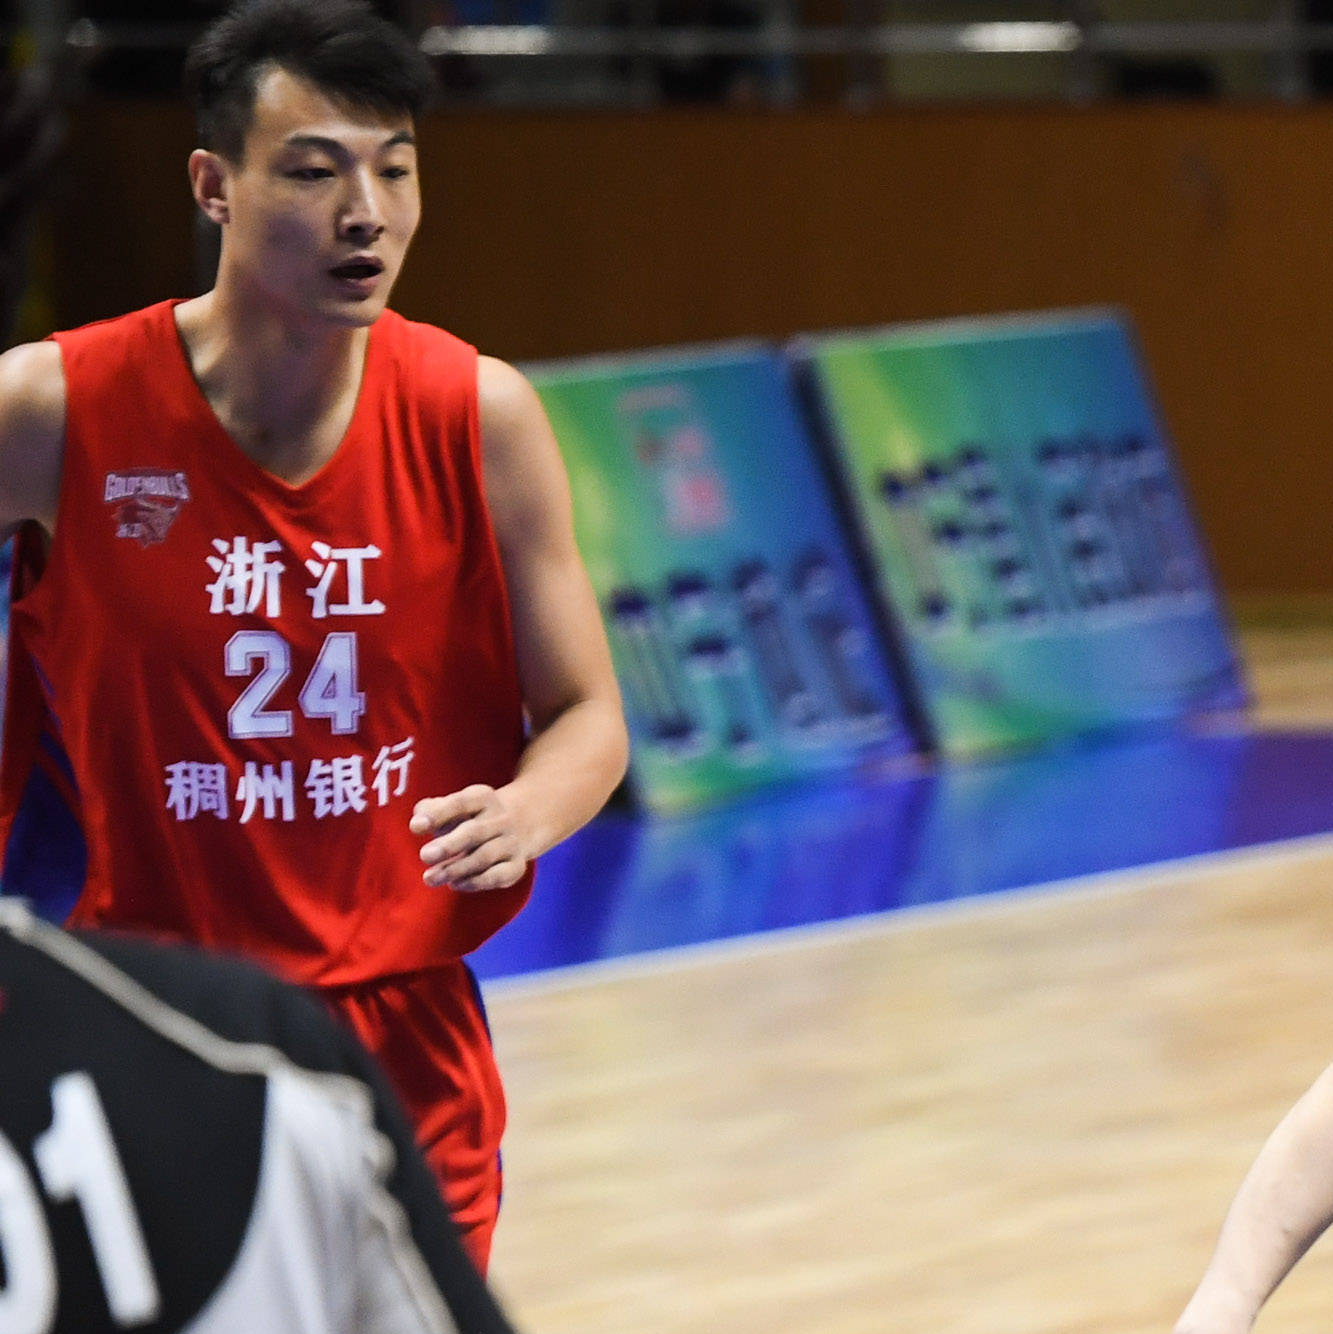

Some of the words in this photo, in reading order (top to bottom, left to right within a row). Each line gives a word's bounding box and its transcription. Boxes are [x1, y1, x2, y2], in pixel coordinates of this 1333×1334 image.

[205, 536, 386, 619] 浙江
[224, 630, 366, 740] 24
[165, 737, 414, 824] 稠州银行
